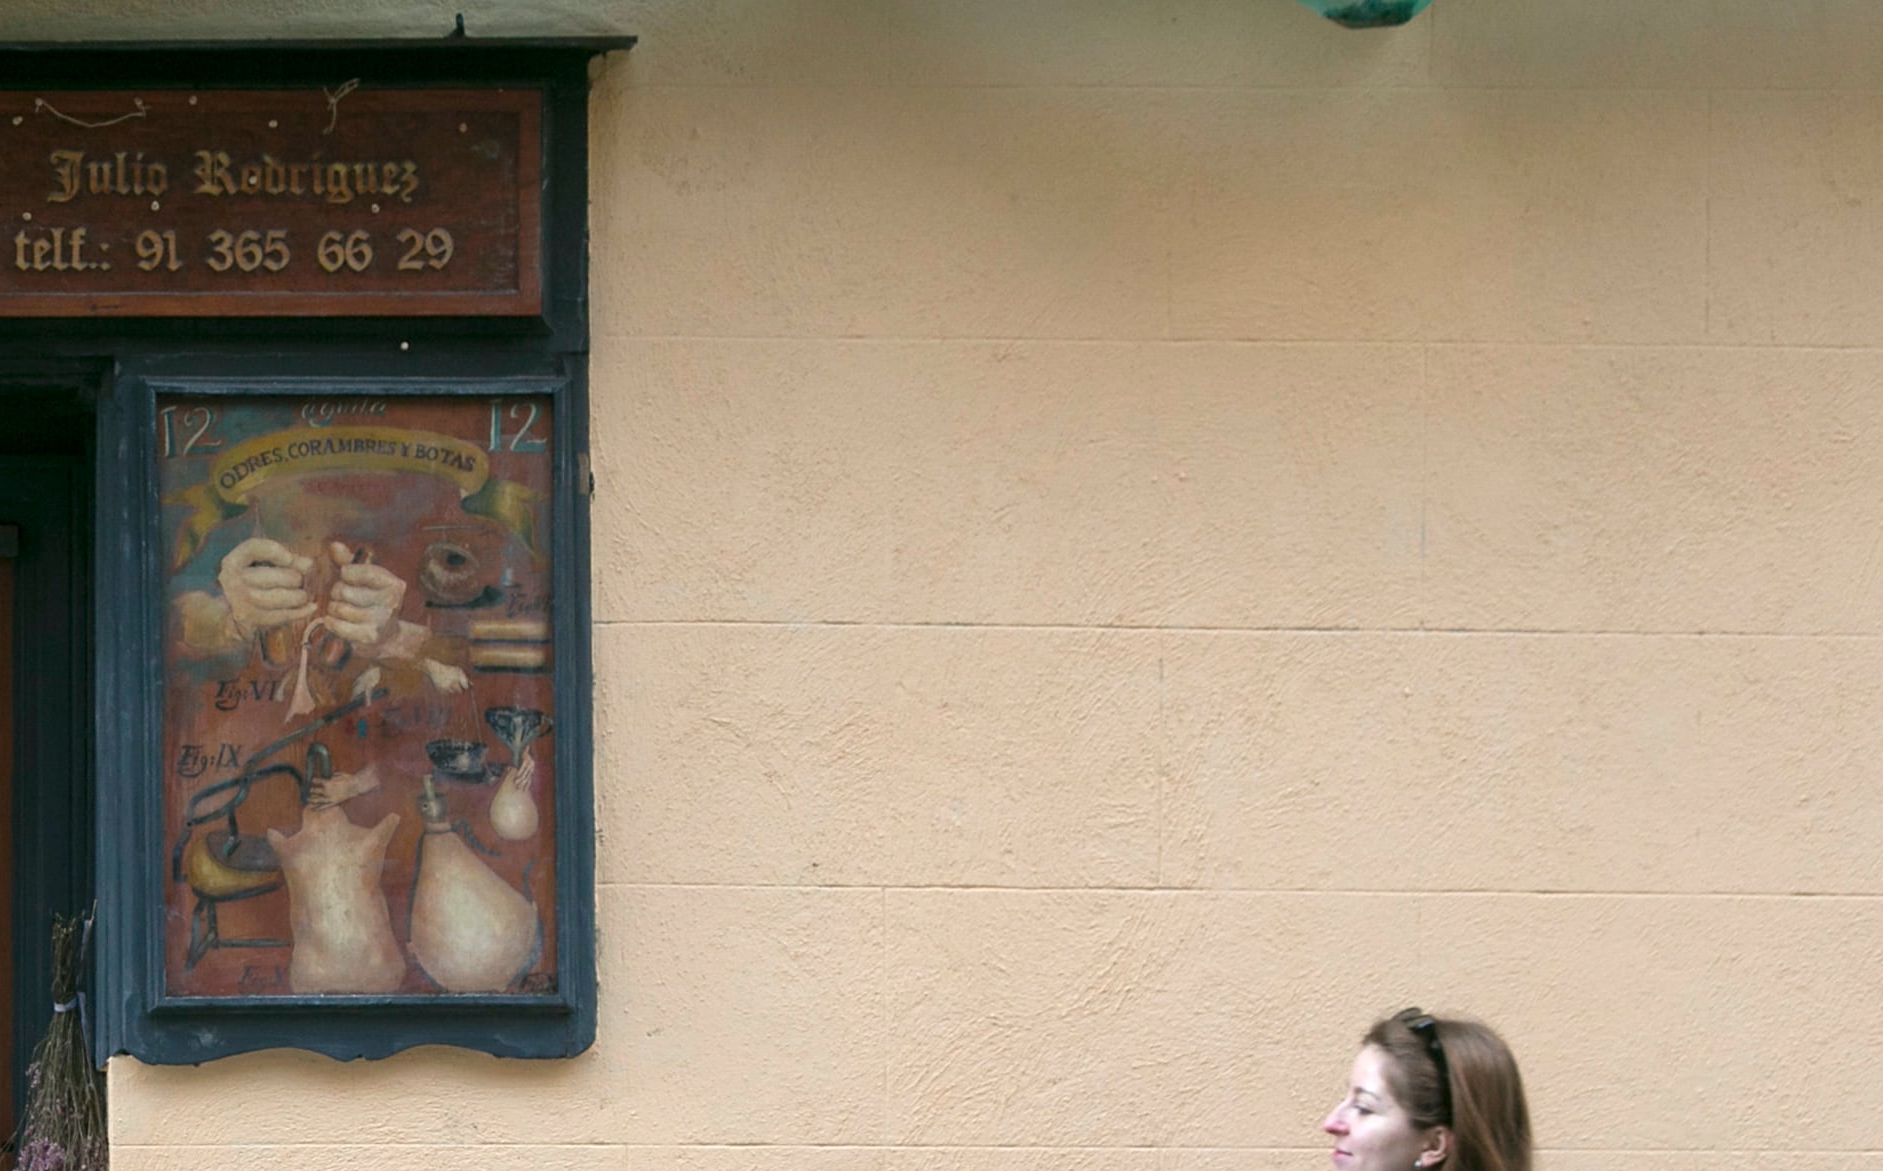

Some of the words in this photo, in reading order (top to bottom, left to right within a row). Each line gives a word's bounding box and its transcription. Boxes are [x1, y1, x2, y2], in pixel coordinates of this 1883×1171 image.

[47, 150, 169, 204] Julio
[135, 229, 182, 273] 91
[206, 229, 291, 273] 365
[317, 229, 373, 273] 66
[396, 227, 455, 273] 29
[159, 403, 222, 459] 12
[489, 398, 548, 454] 12
[400, 442, 411, 458] Y
[415, 444, 476, 473] BOTAS
